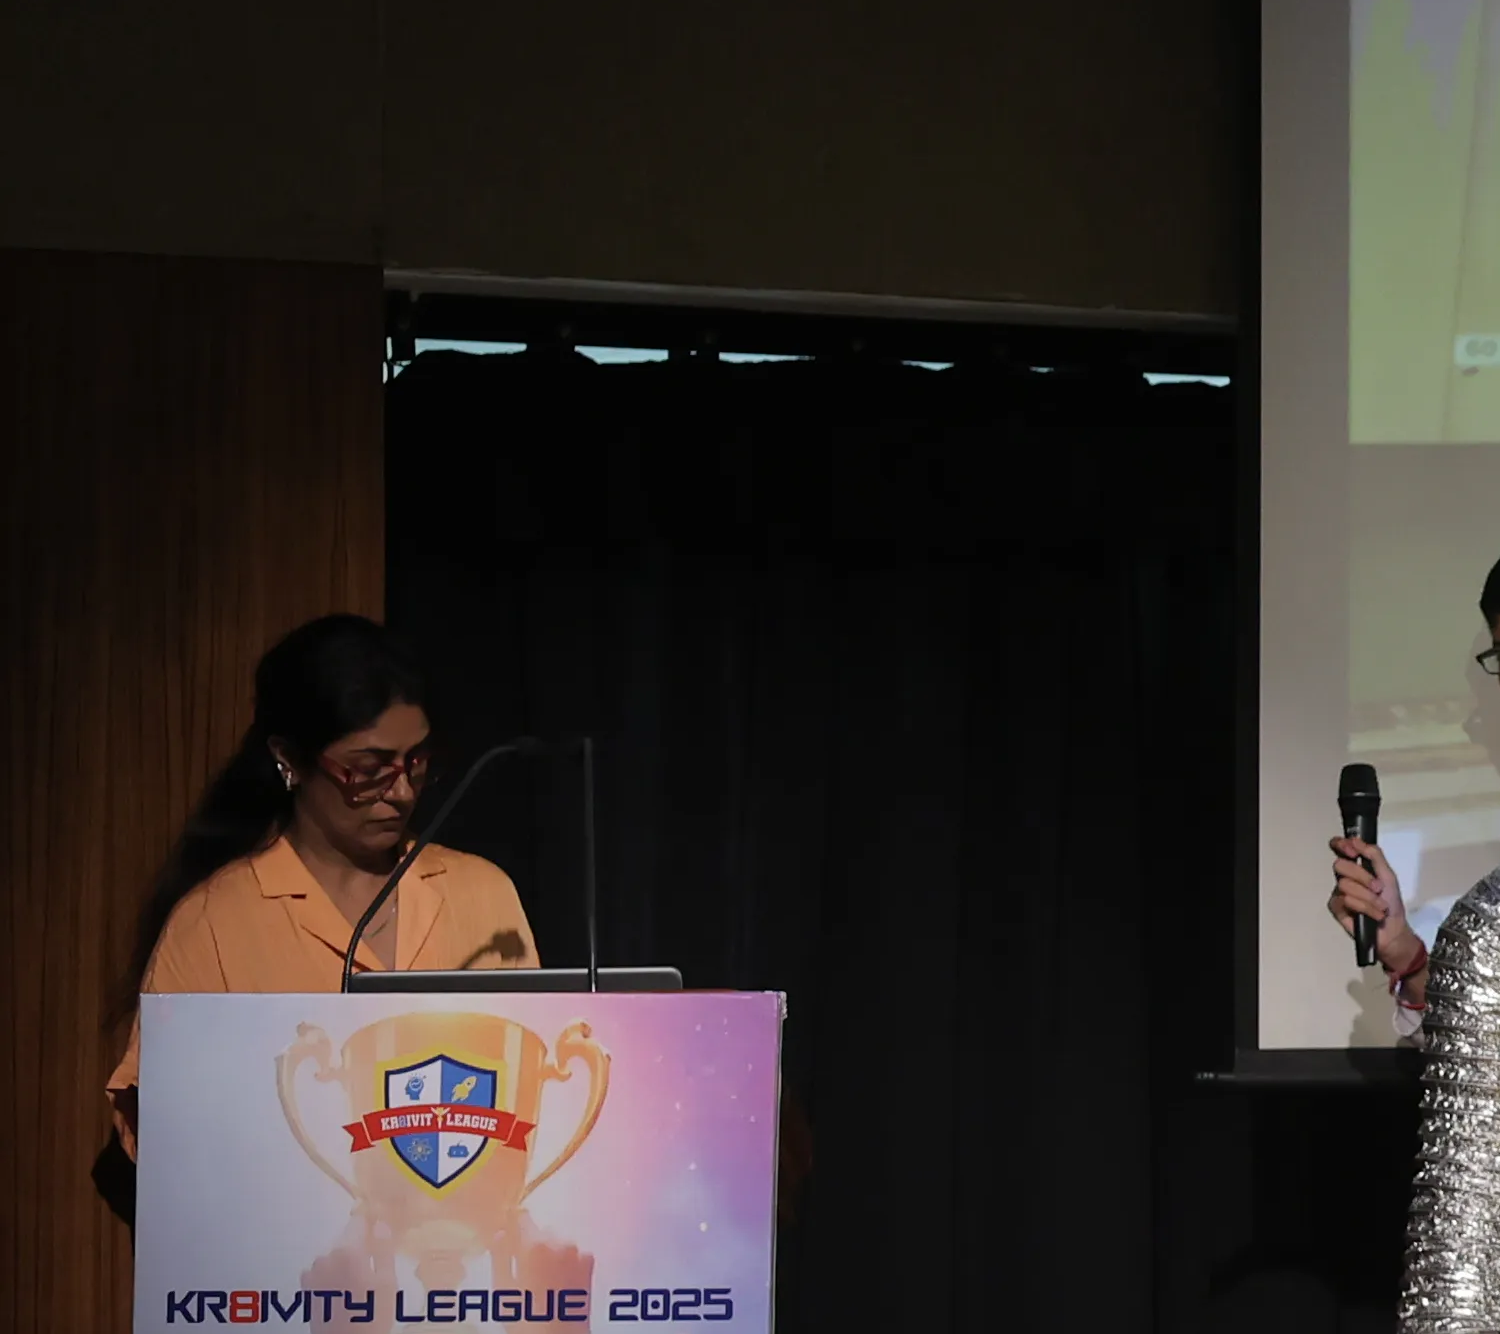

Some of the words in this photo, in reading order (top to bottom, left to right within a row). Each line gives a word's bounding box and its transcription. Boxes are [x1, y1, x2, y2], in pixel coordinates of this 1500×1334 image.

[446, 1113, 498, 1132] LEAGUE
[166, 1289, 375, 1324] KR8IVITY
[395, 1288, 588, 1323] LEAGUE
[608, 1287, 734, 1323] 2025
